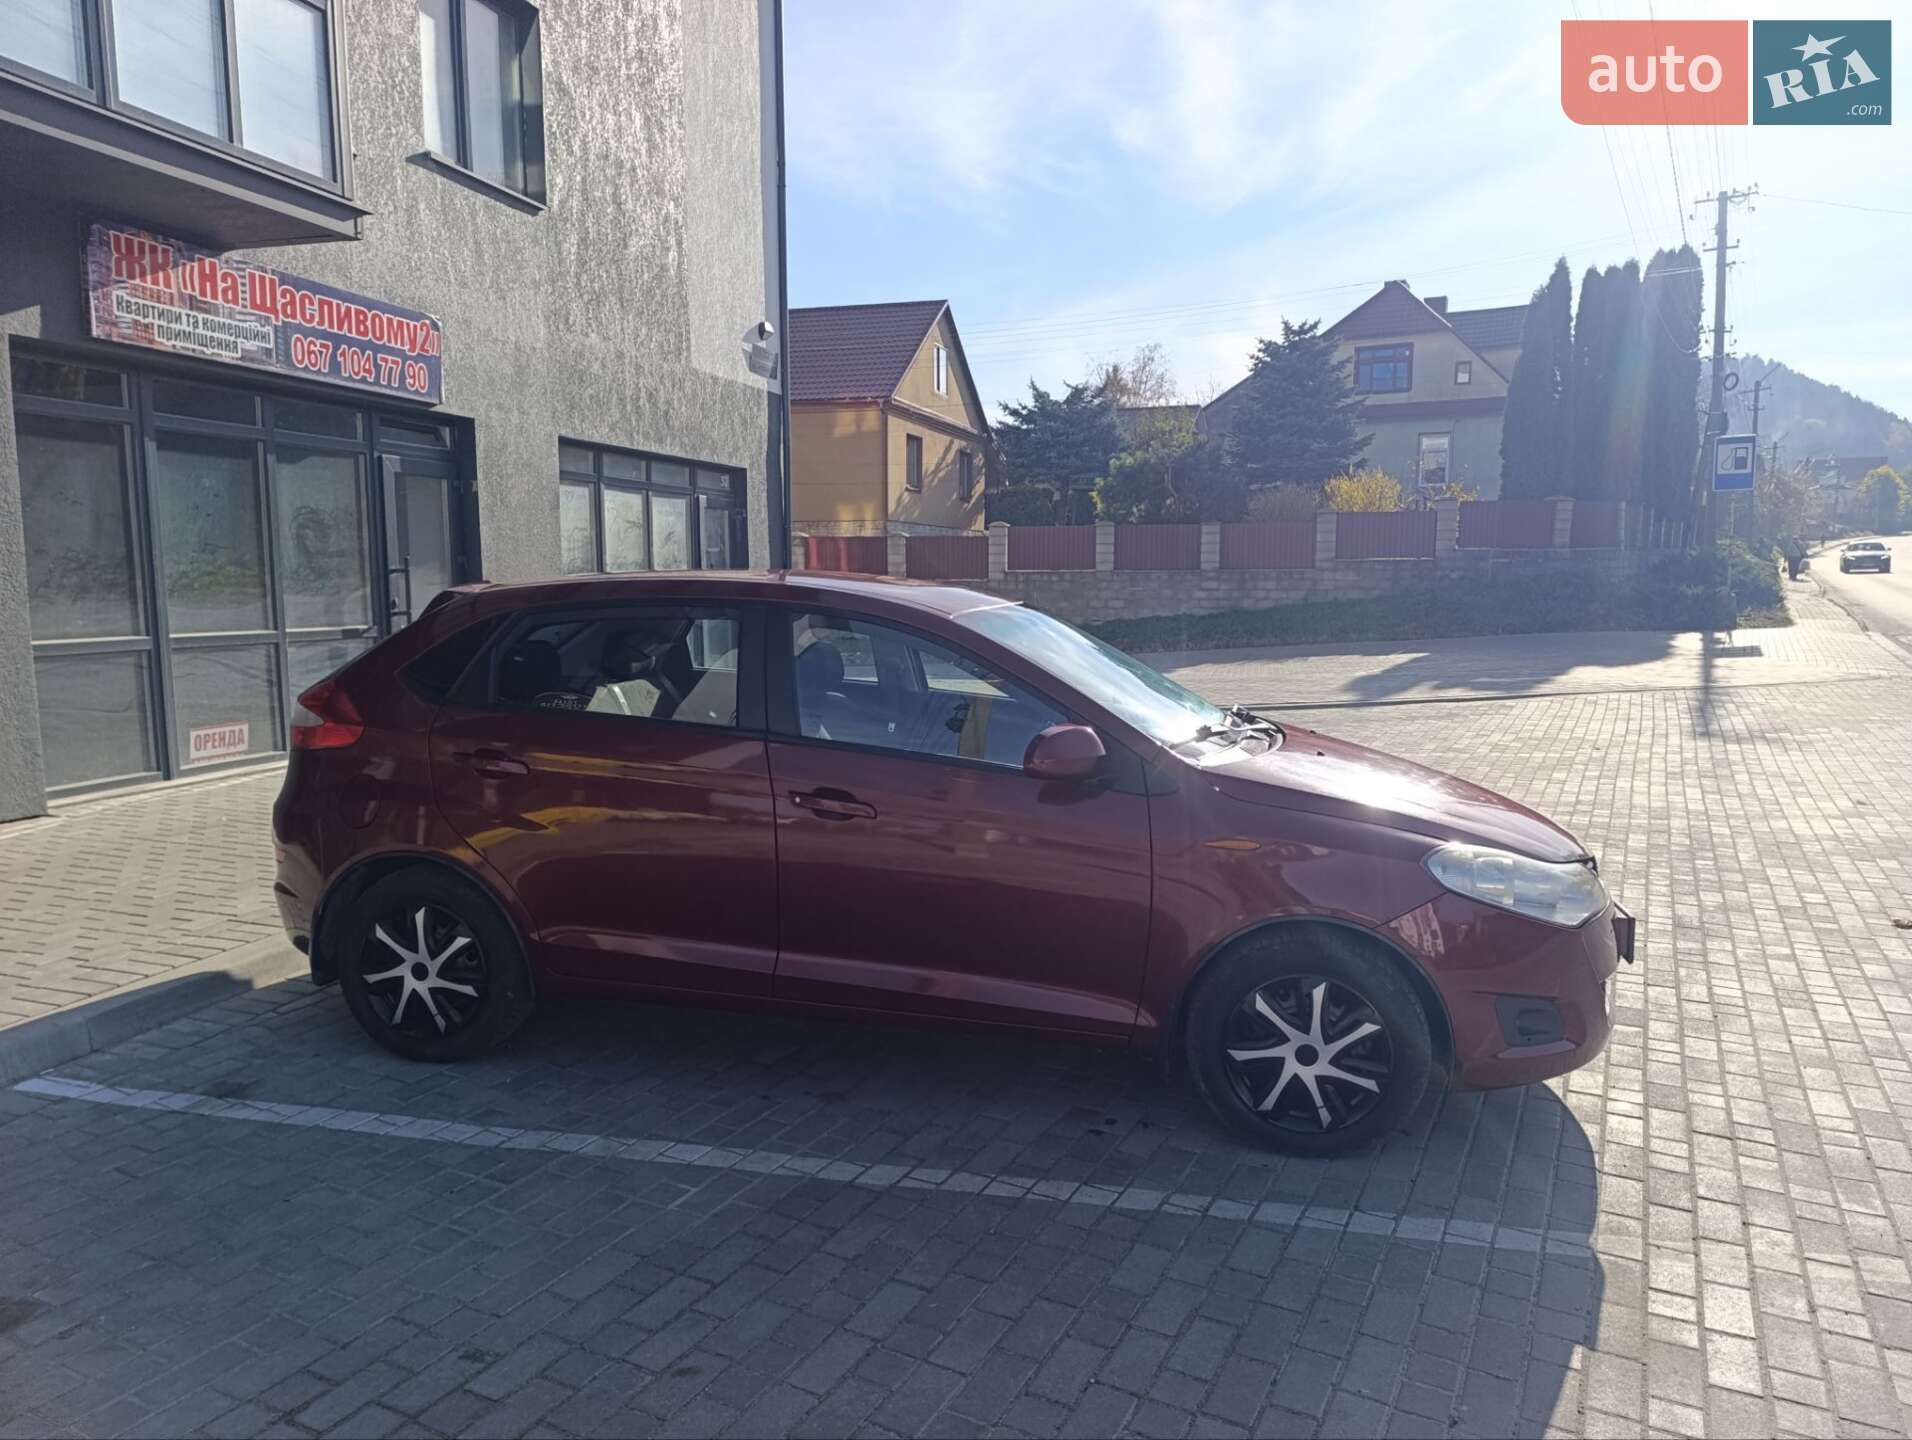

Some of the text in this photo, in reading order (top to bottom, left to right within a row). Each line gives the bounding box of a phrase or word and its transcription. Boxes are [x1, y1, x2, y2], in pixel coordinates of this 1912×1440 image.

[110, 231, 173, 292] ЖК
[115, 295, 272, 345] Квартири та комерційні
[157, 324, 239, 354] приміщення
[292, 335, 429, 394] 067 104 77 90
[194, 728, 245, 751] ОРЕНДА
